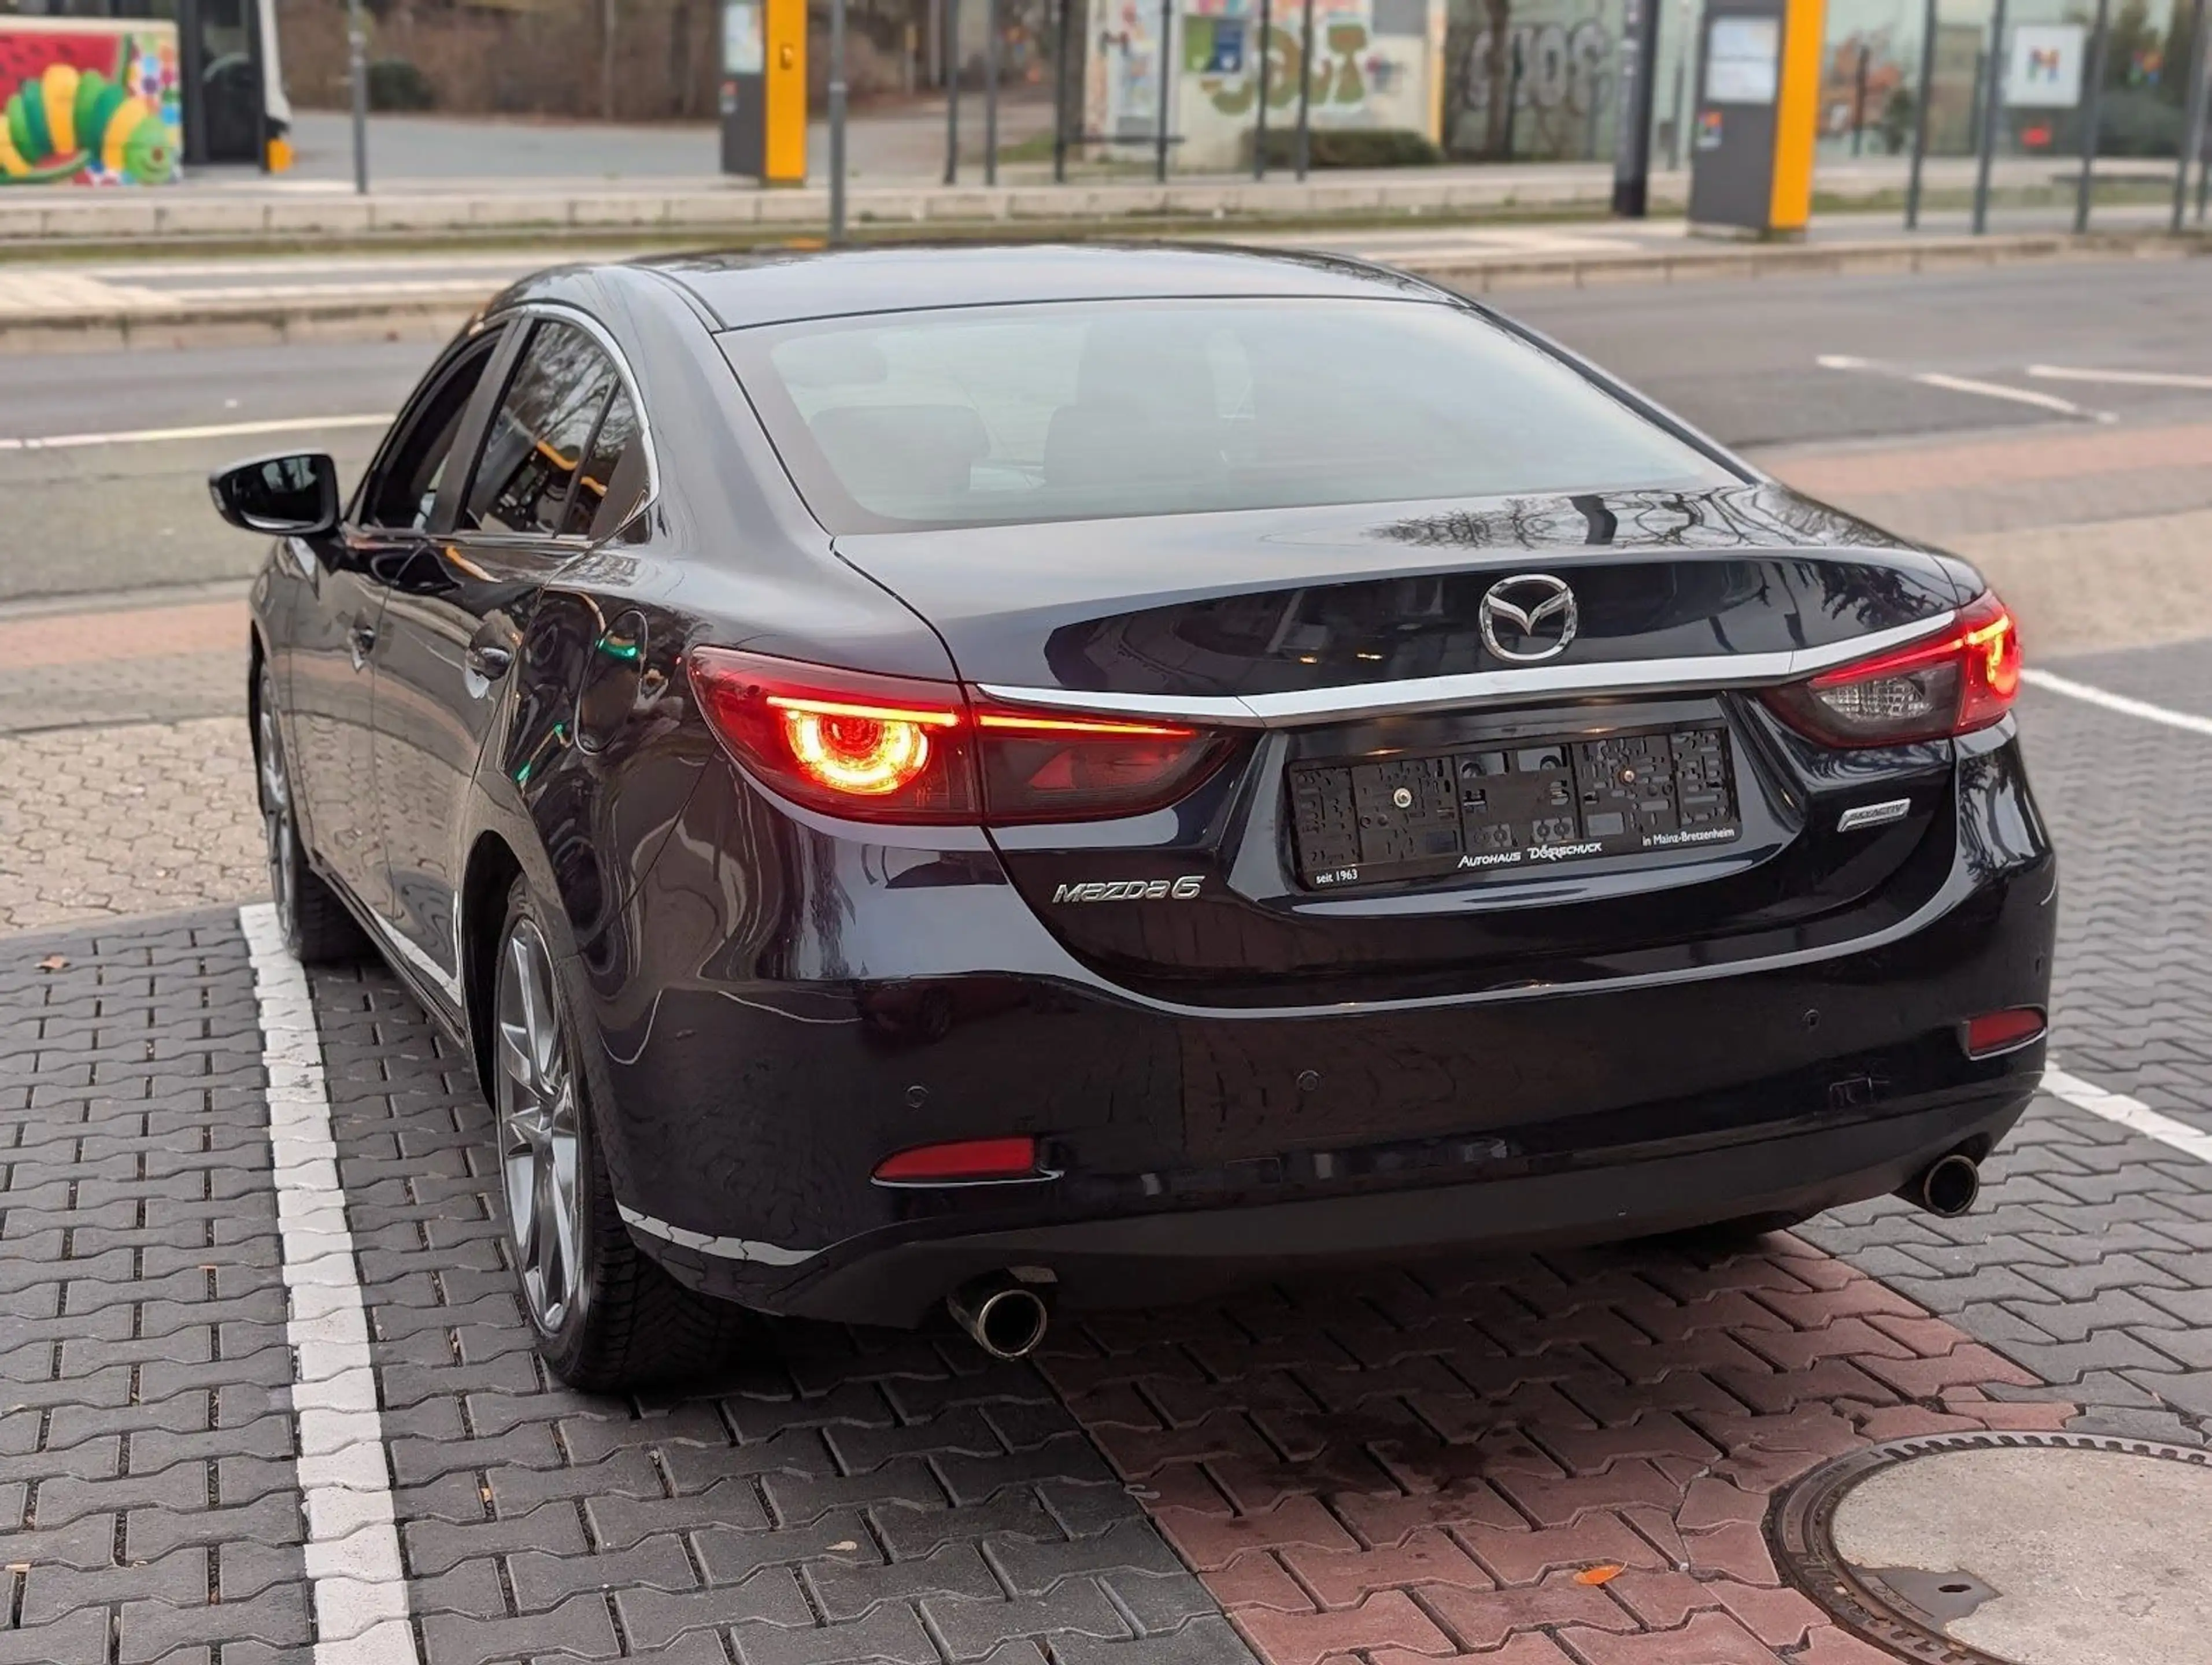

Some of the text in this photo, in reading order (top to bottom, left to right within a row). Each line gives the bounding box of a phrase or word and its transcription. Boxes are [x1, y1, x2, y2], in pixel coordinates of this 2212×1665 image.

[1643, 828, 1734, 846] in Mainz-Bretzenheim
[1458, 852, 1521, 868] AUTOHAUS
[1316, 868, 1358, 884] seit 1963
